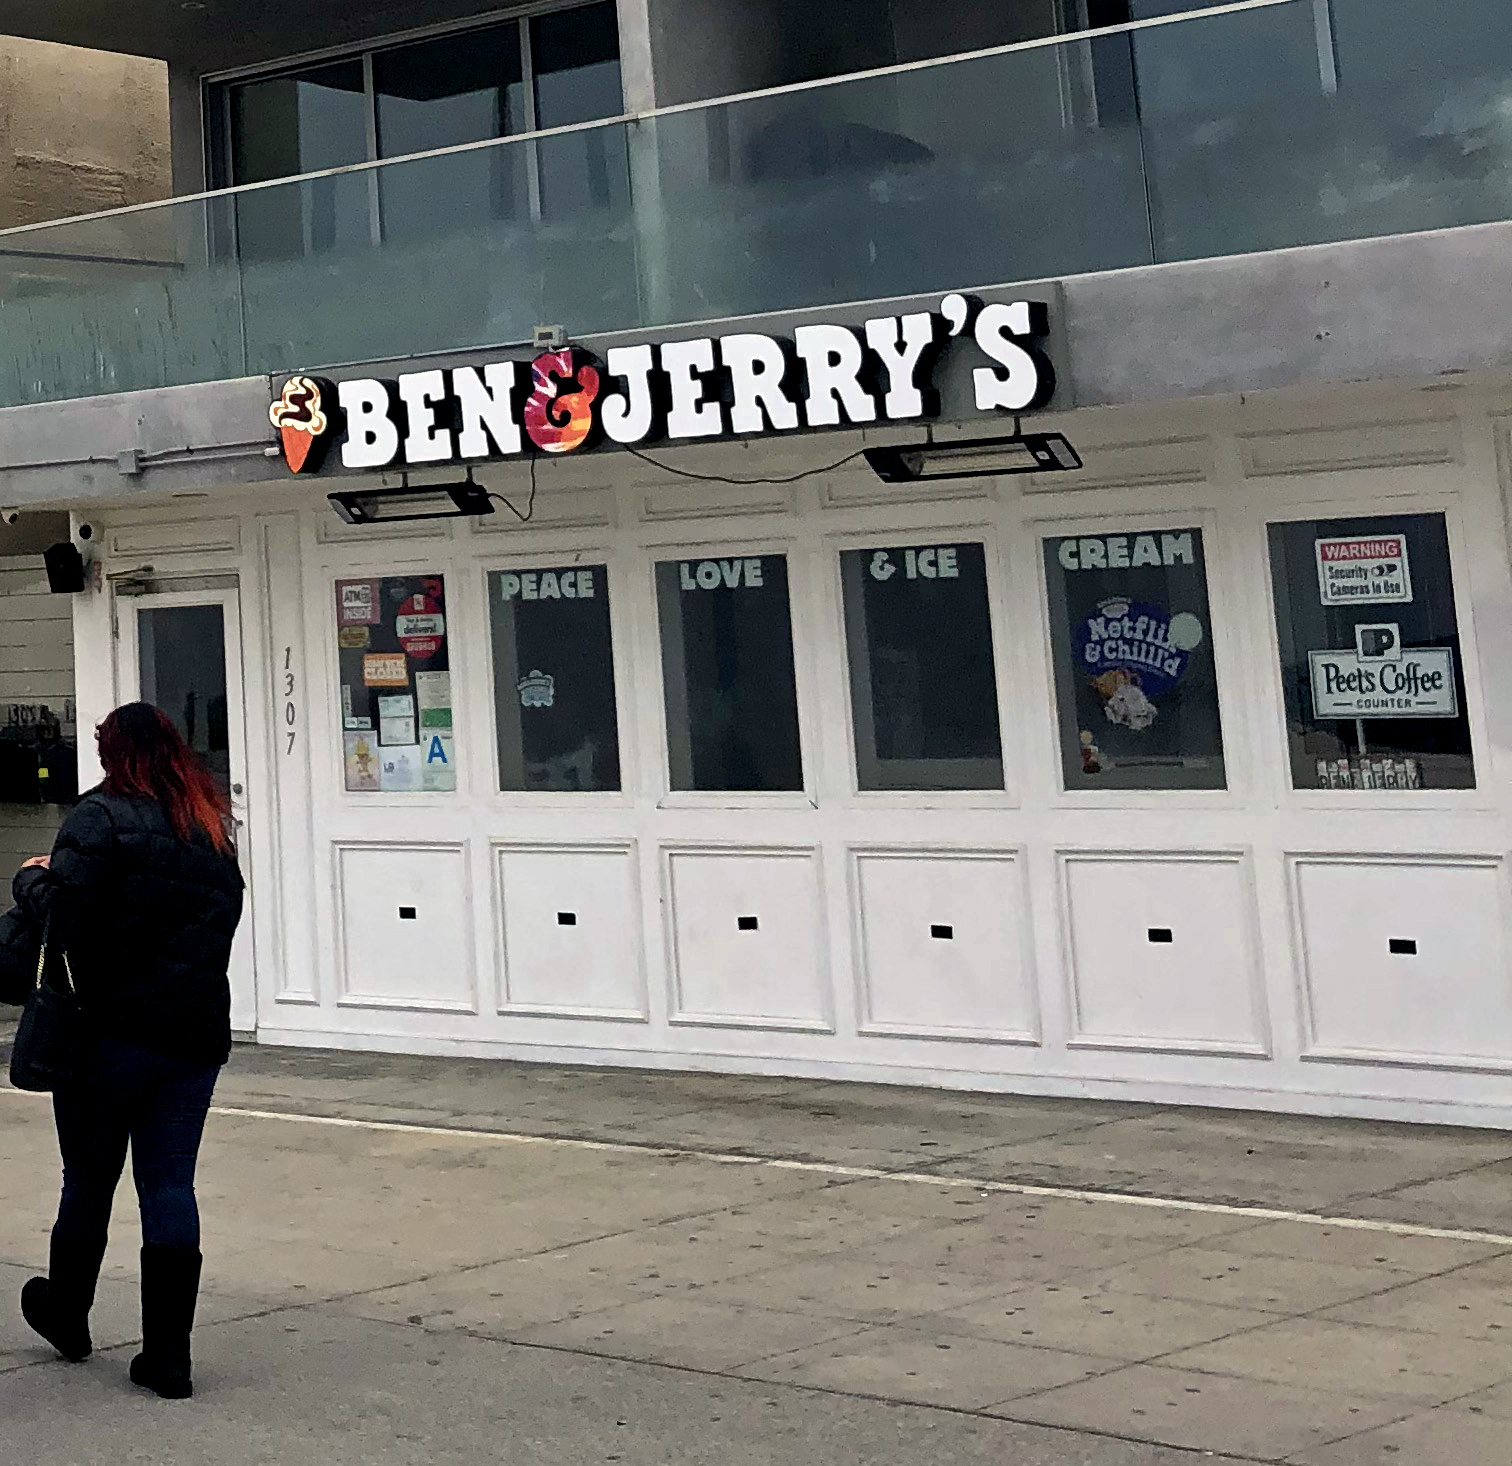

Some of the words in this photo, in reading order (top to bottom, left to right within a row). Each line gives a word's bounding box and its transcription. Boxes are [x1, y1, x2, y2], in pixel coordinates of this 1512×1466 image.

[869, 551, 895, 581] &
[904, 548, 958, 579] ICE
[1058, 533, 1194, 570] CREAM
[1325, 541, 1399, 559] WARNING
[501, 571, 594, 600] PEACE
[680, 559, 763, 591] LOVE
[1328, 565, 1368, 580] Security
[344, 590, 361, 603] ATM
[1330, 582, 1370, 596] Cameras
[1372, 581, 1382, 594] In
[1384, 580, 1400, 594] Use
[1088, 615, 1180, 654] Netfli
[1321, 663, 1376, 694] Peet's
[1379, 662, 1443, 697] Coffee
[284, 646, 296, 755] 1307
[1357, 698, 1412, 708] COUNTER
[427, 735, 448, 763] A
